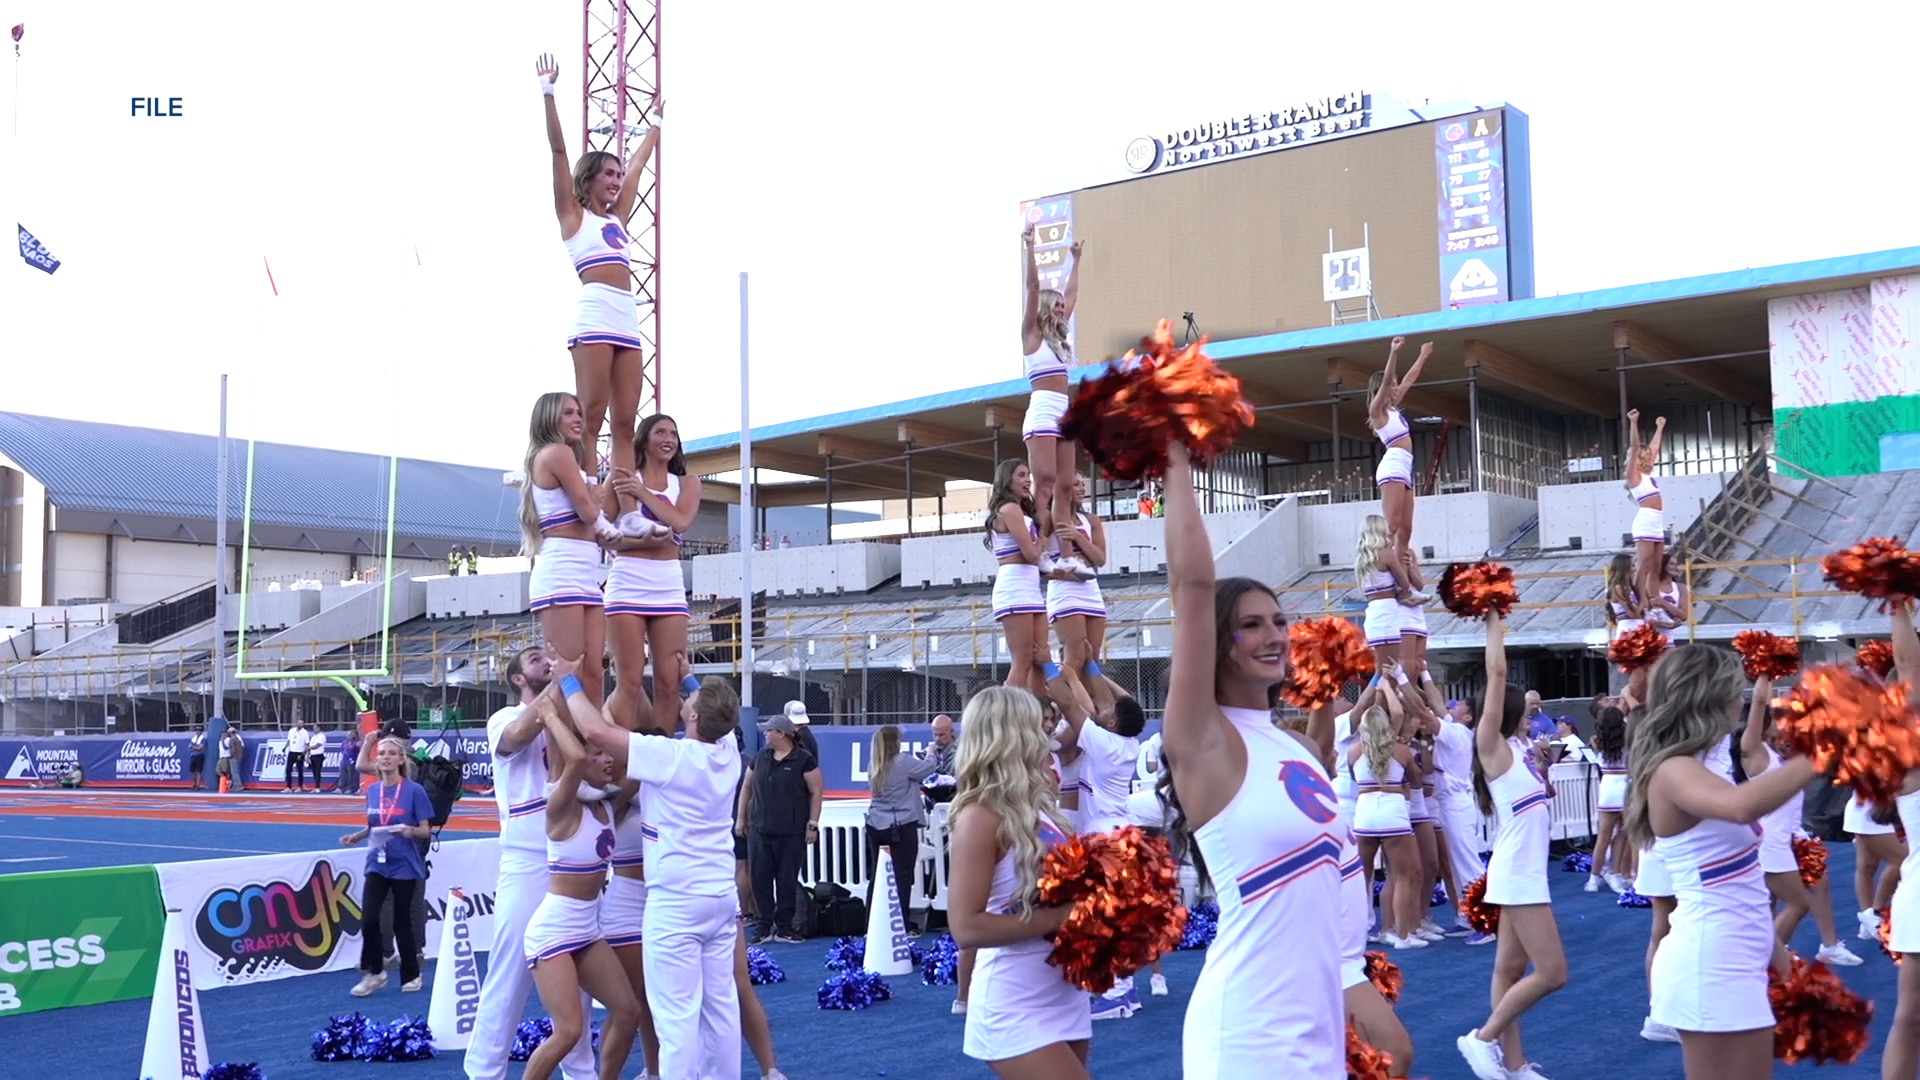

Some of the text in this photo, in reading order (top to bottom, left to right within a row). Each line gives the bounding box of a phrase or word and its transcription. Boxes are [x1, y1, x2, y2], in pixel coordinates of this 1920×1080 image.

[1165, 113, 1253, 150] DOUBLE
[1281, 90, 1365, 127] RANCH
[1164, 111, 1366, 168] Northwest Beef
[1050, 204, 1059, 218] 7
[1049, 227, 1060, 241] 0
[1329, 256, 1361, 293] 25
[36, 749, 79, 761] MOUNTAIN
[121, 739, 177, 758] Atkinson's
[265, 746, 287, 768] Tires
[115, 758, 145, 773] MIRROR
[152, 758, 181, 774] GLASS
[208, 863, 363, 957] cmyk
[885, 860, 912, 963] BRONCOS
[0, 934, 106, 973] CESS
[231, 931, 293, 955] GRAFIX
[174, 949, 200, 1079] BRONCOS
